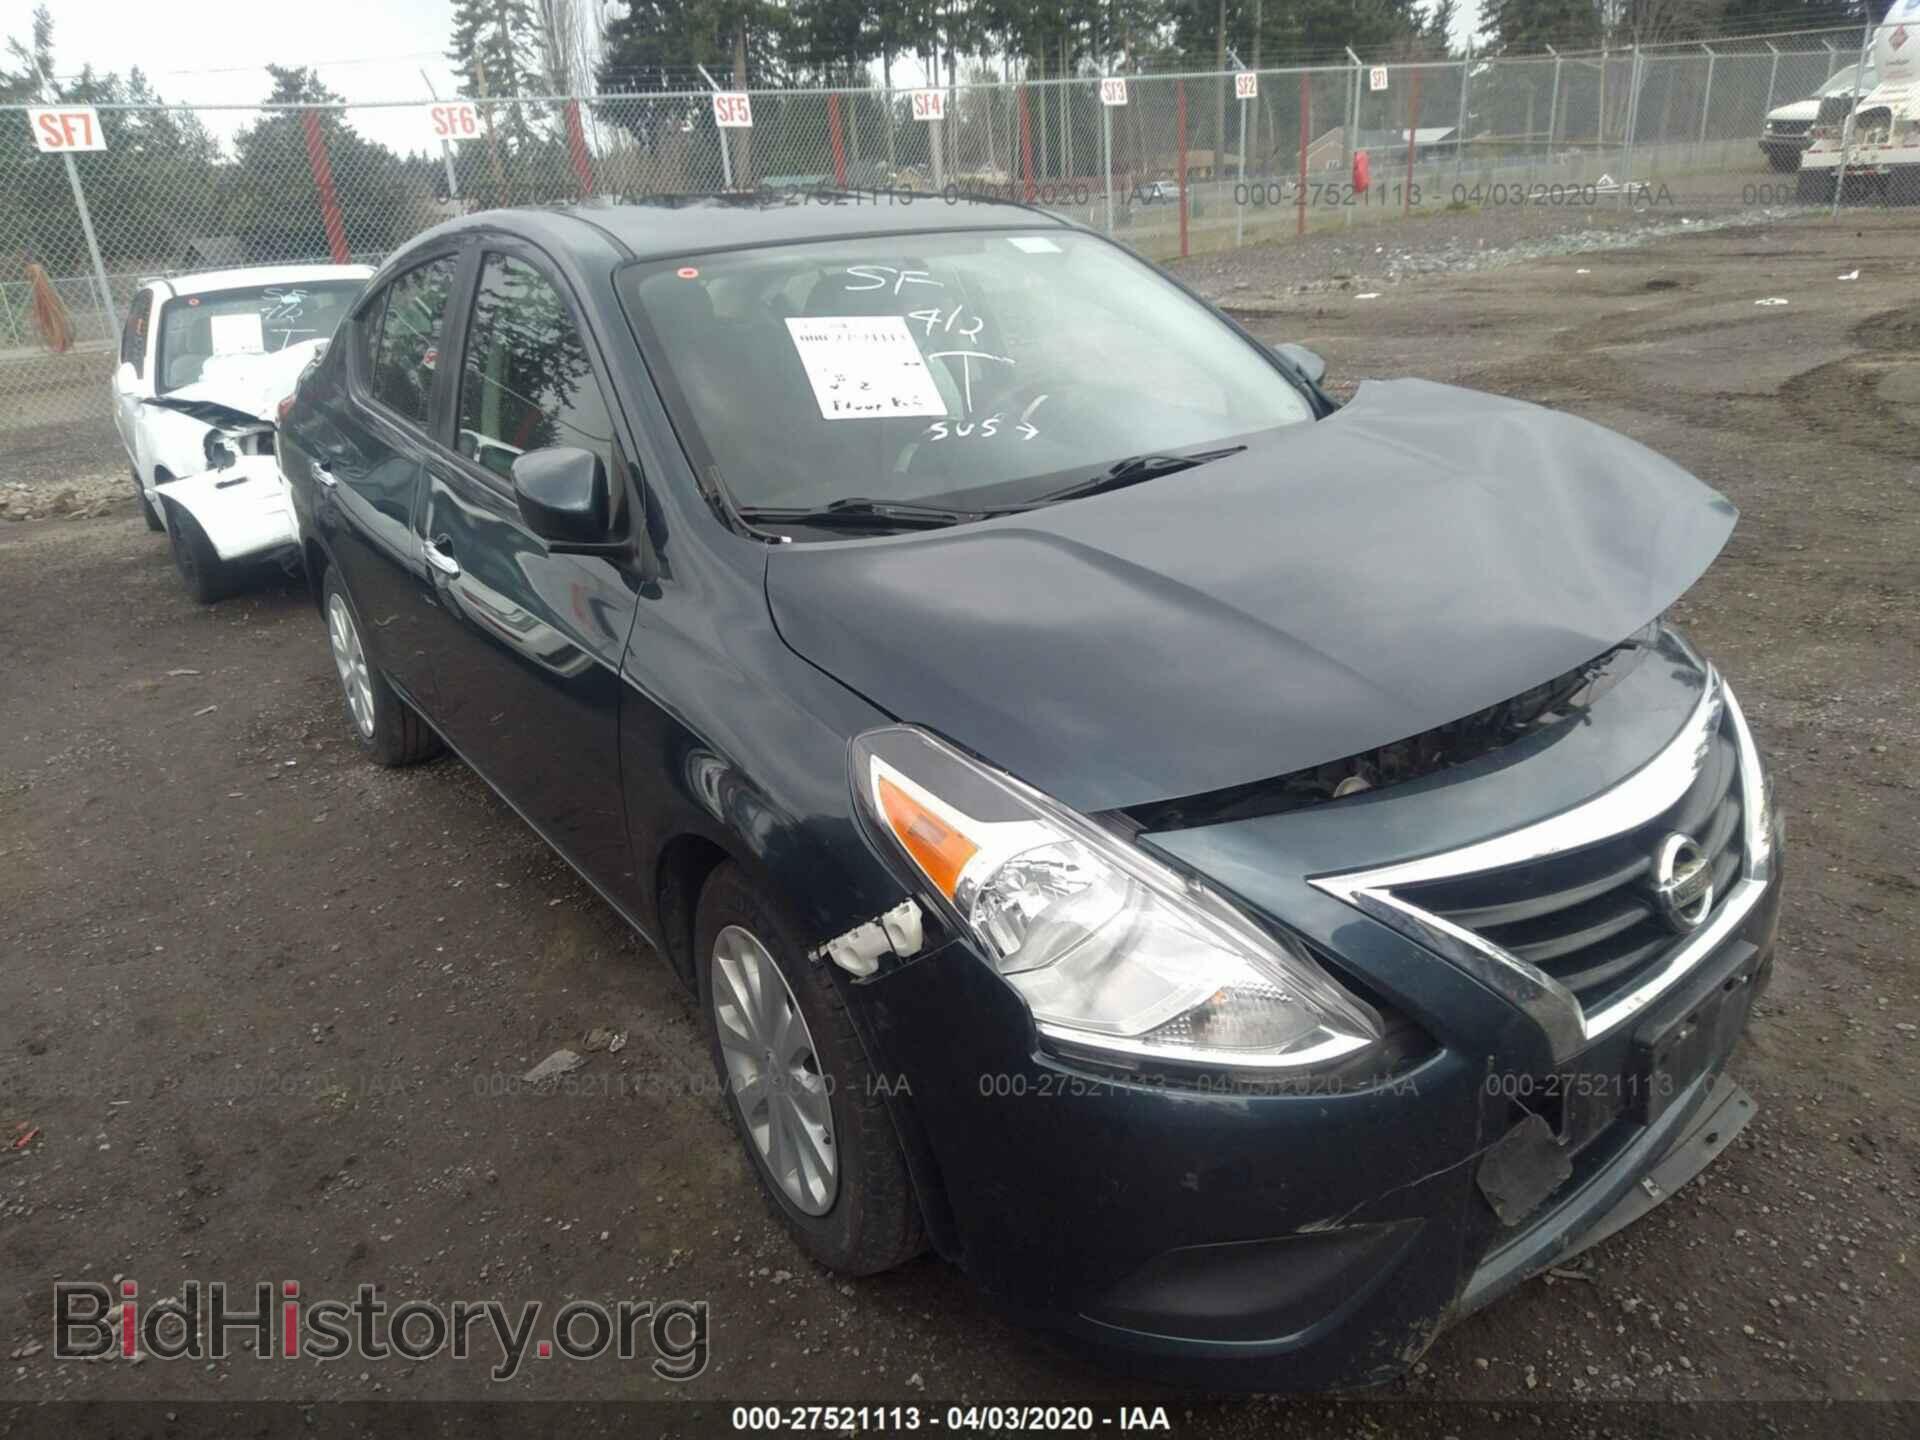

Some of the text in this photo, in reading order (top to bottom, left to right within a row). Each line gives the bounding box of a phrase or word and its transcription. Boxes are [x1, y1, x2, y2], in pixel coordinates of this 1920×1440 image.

[716, 97, 749, 122] SF5
[914, 94, 941, 116] SF4
[39, 113, 93, 147] SF7
[431, 106, 475, 136] SF6
[845, 265, 944, 295] SF
